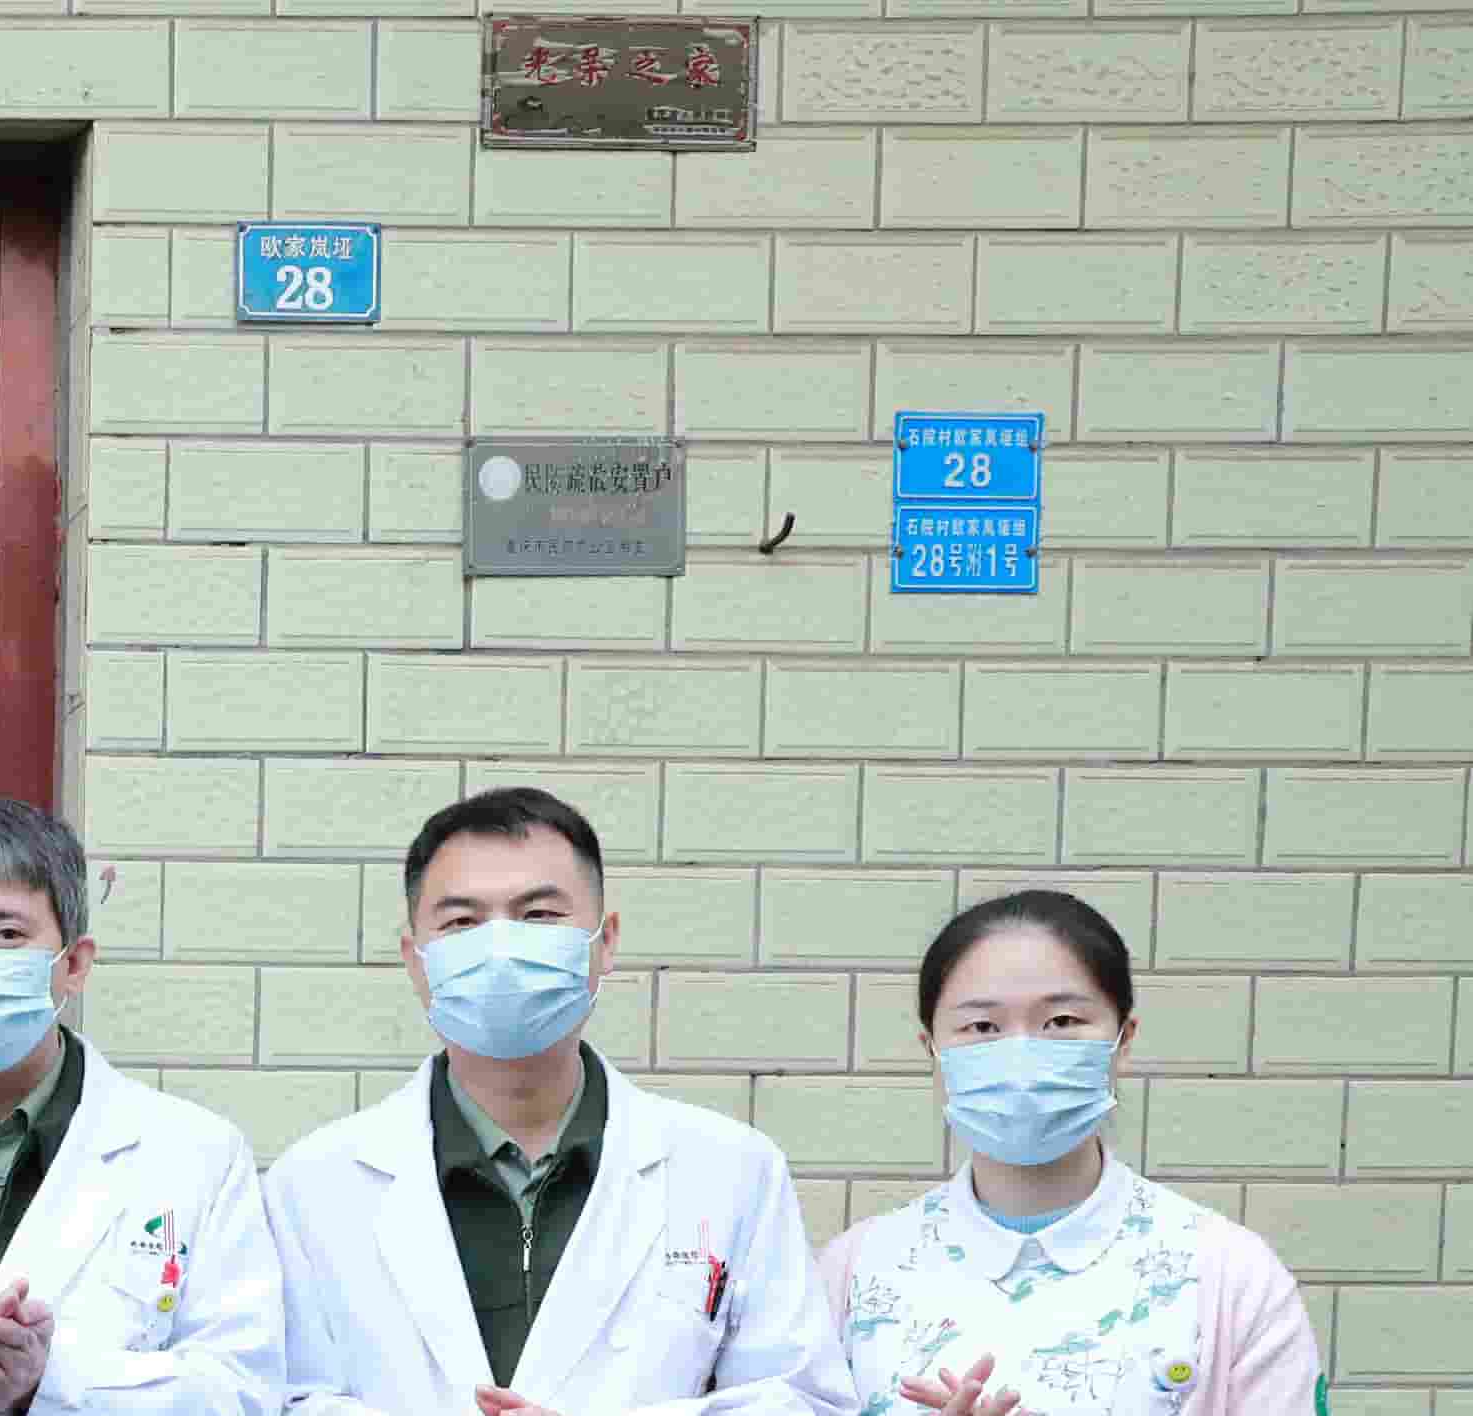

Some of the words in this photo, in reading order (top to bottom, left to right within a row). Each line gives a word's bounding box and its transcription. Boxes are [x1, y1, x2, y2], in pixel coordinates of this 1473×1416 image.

[524, 43, 721, 89] 光荣之家
[276, 264, 334, 311] 28
[943, 452, 992, 487] 28
[911, 543, 1020, 577] 28号附1号
